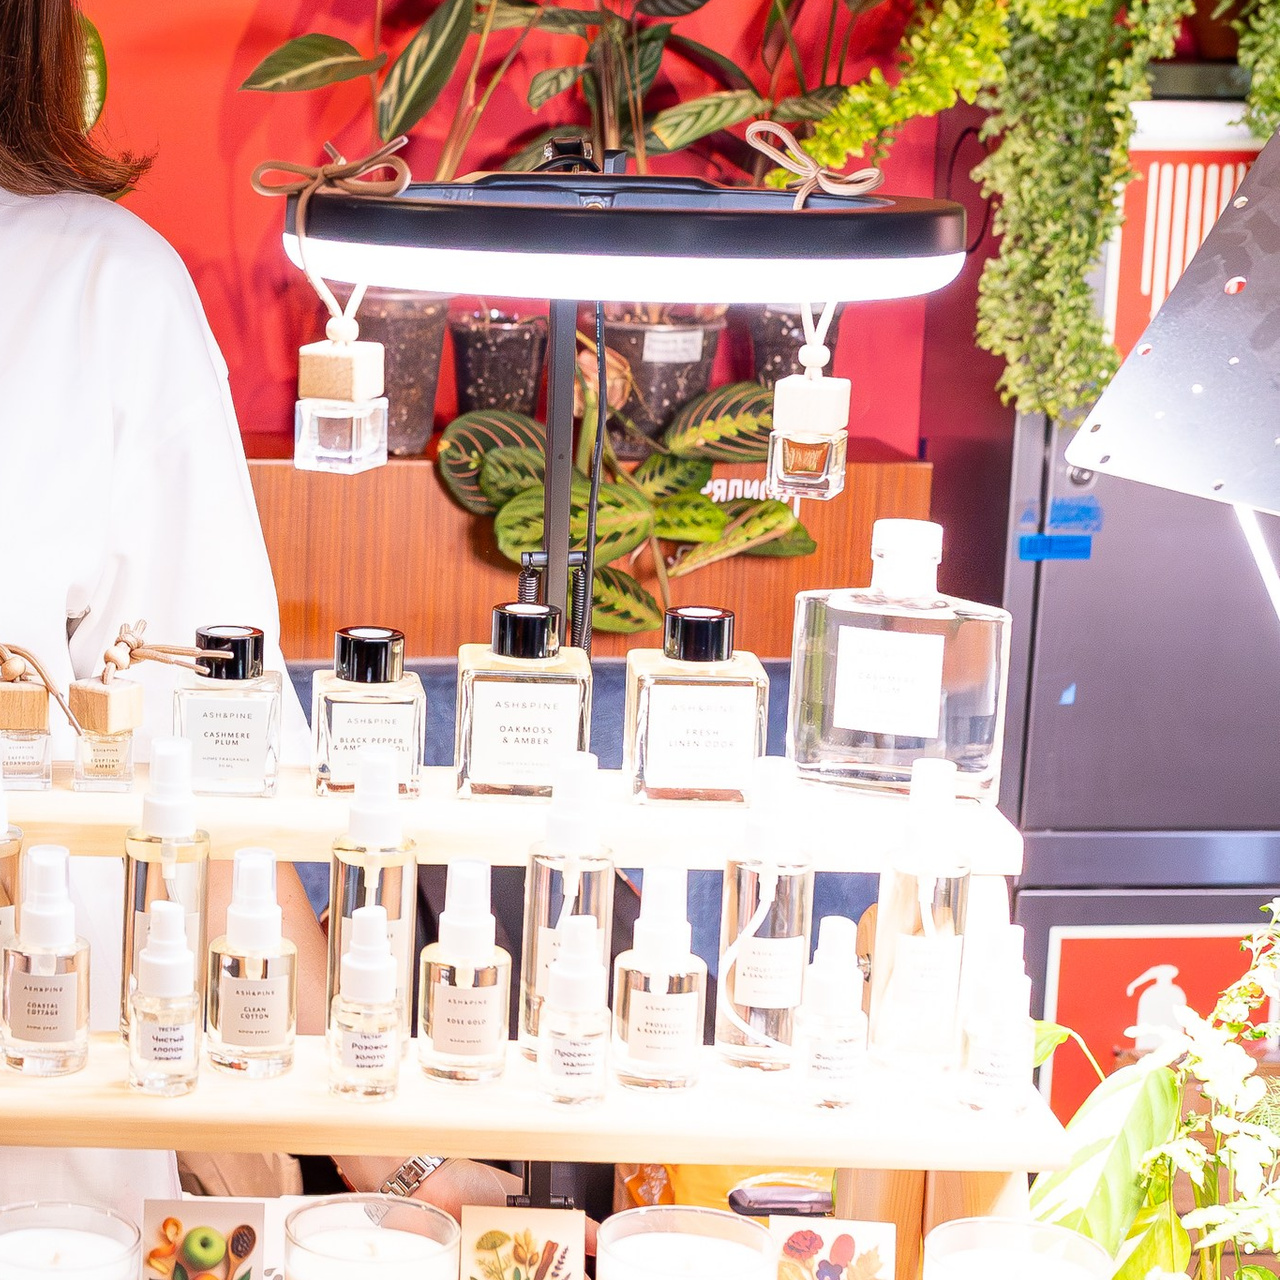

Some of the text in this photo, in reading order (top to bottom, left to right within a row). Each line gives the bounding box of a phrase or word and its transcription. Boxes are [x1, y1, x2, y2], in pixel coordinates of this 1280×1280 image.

[494, 700, 561, 711] ASH&PINE
[202, 711, 253, 720] ASH&PINE
[346, 717, 398, 726] ASH&PINE
[499, 724, 553, 735] OAKMOSS
[203, 730, 251, 740] CASHMERE
[214, 738, 240, 746] PLUM
[339, 736, 404, 745] BLACK PEPPER
[502, 735, 550, 745] & AMBER
